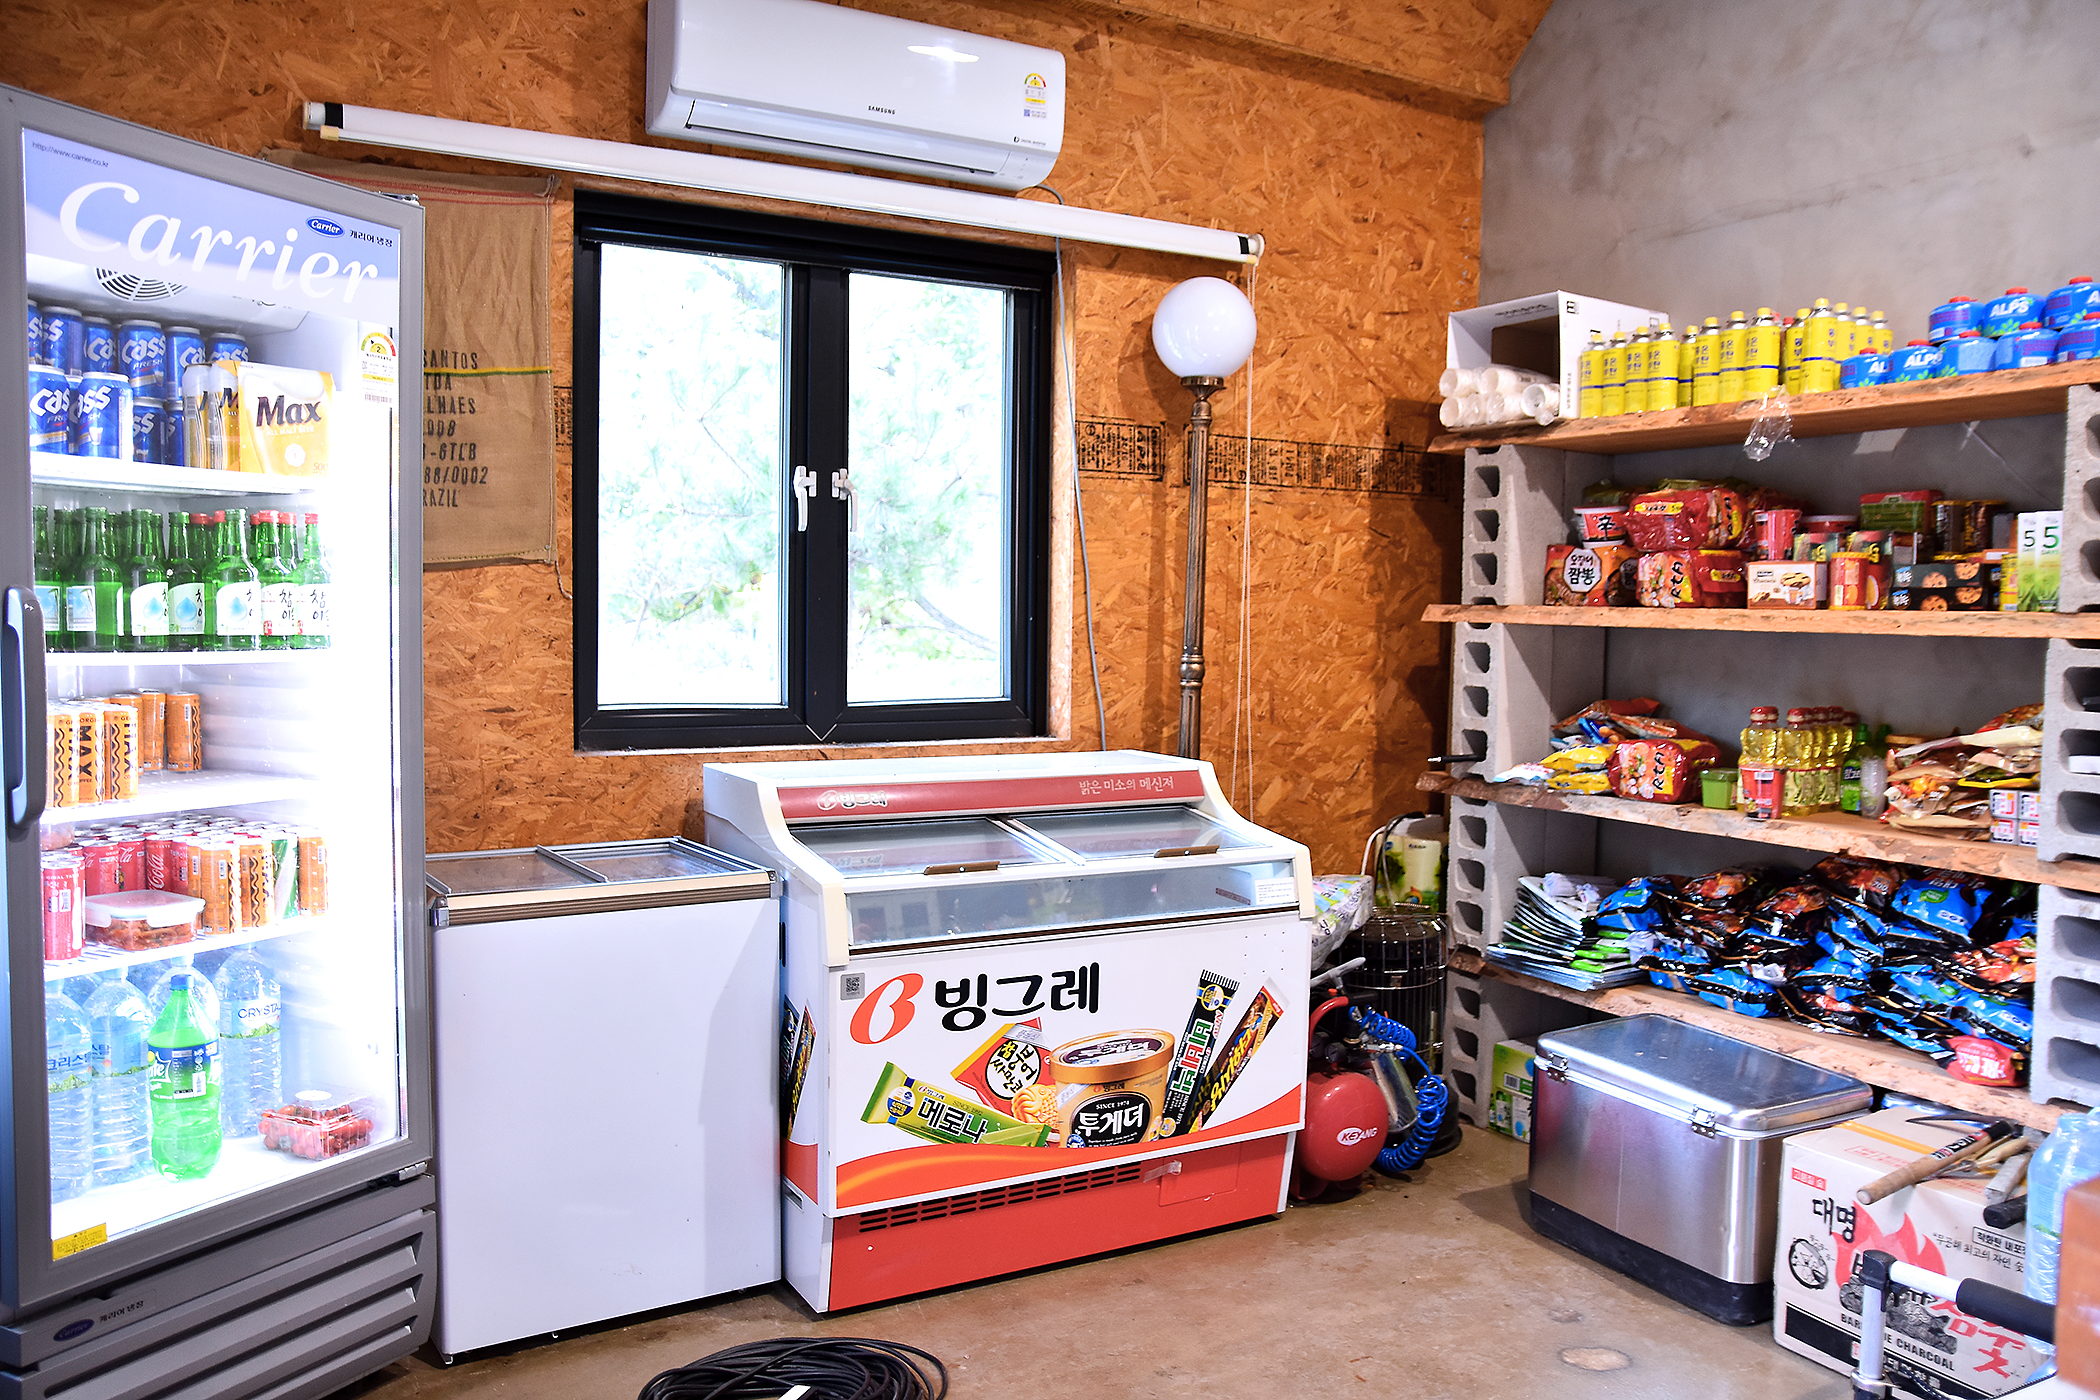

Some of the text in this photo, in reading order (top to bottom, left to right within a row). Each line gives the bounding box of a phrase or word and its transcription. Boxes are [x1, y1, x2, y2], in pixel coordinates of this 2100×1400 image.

[868, 105, 896, 115] SAMSUNG
[310, 219, 342, 235] Carrier
[60, 181, 379, 303] Carrier
[350, 229, 393, 247] 캐리어 냉장
[1989, 300, 2029, 318] ALPS
[1868, 361, 1888, 373] AL
[256, 395, 322, 427] Max
[1597, 515, 1616, 541] 辛
[2043, 526, 2059, 549] 5
[2024, 530, 2035, 547] 5
[1571, 553, 1593, 567] 오징어
[1568, 567, 1596, 586] 짬뽕
[279, 589, 292, 608] 참
[310, 589, 326, 608] 참
[79, 725, 93, 776] MAX
[1079, 776, 1175, 795] 밝은 미소의 메신저
[838, 790, 889, 809] 빙그레
[935, 962, 1100, 1032] 빙그레
[1008, 1044, 1038, 1080] 붕어
[1171, 1019, 1213, 1093] 비비빅
[989, 1058, 1023, 1094] 싸만코
[1103, 1082, 1125, 1092] 빙그레
[1096, 1101, 1115, 1110] SINCE
[917, 1096, 988, 1144] 메로나
[1078, 1103, 1144, 1137] 투게더
[1341, 1127, 1378, 1142] KEYANG
[1812, 1197, 1857, 1243] 대명
[1964, 1243, 1991, 1262] 최고의
[1993, 1255, 2011, 1270] 자연
[1896, 1338, 1955, 1371] CHARCOAL
